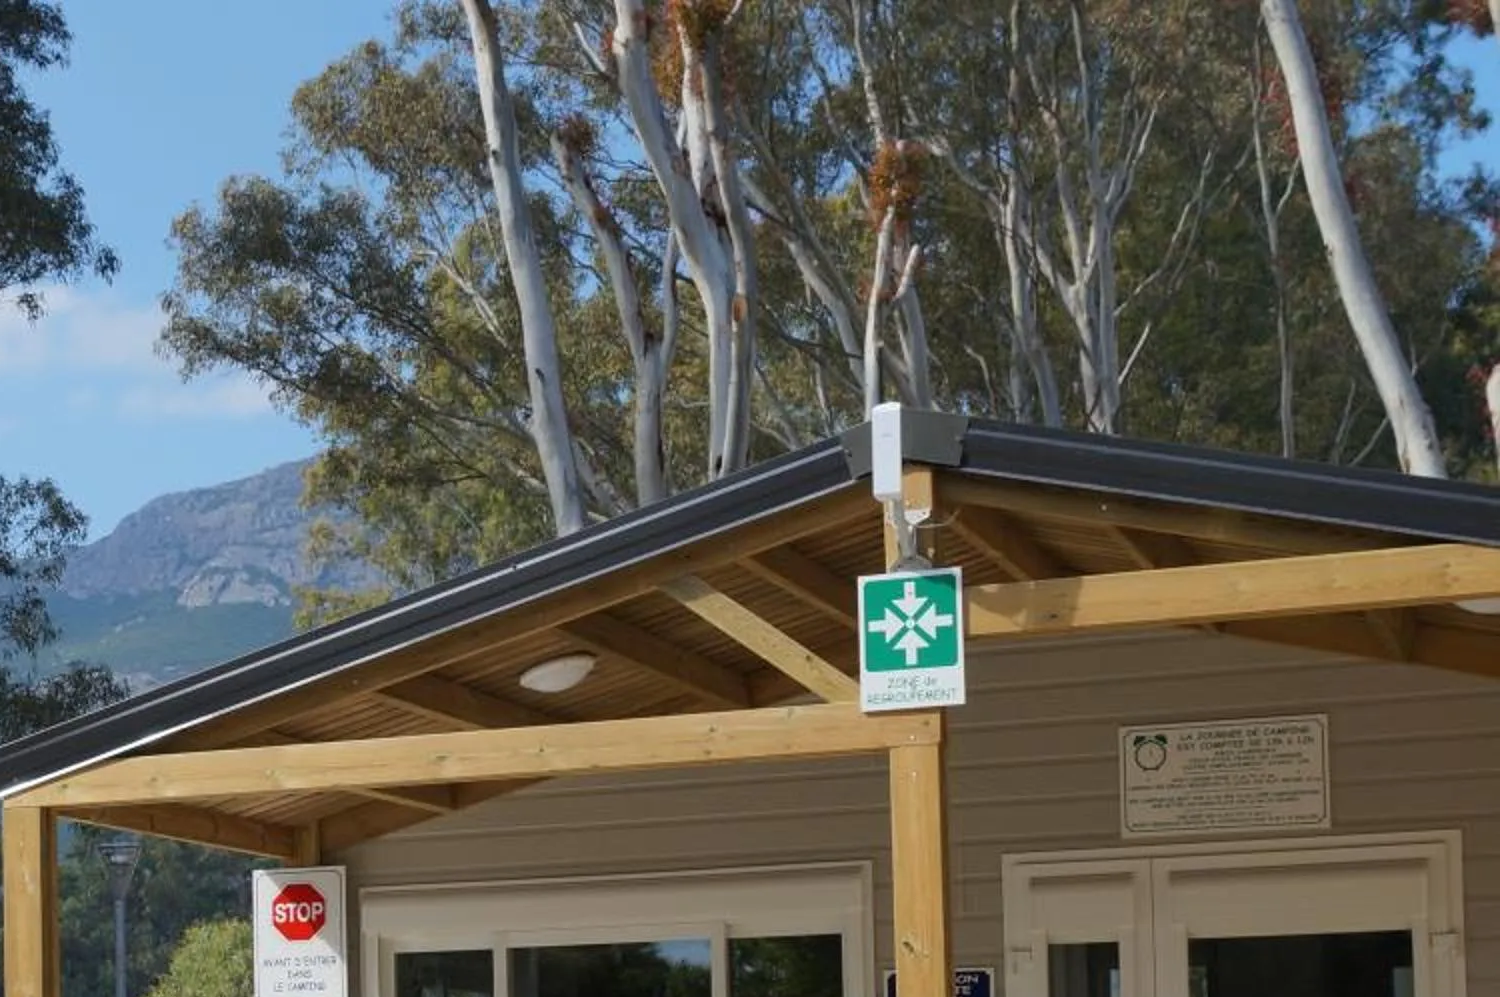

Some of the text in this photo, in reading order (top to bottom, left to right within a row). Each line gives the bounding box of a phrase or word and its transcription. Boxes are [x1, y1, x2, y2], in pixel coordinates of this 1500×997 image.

[275, 903, 324, 923] STOP
[263, 958, 292, 967] AVANT
[287, 969, 312, 978] DANS
[273, 981, 327, 992] LE CAMPING
